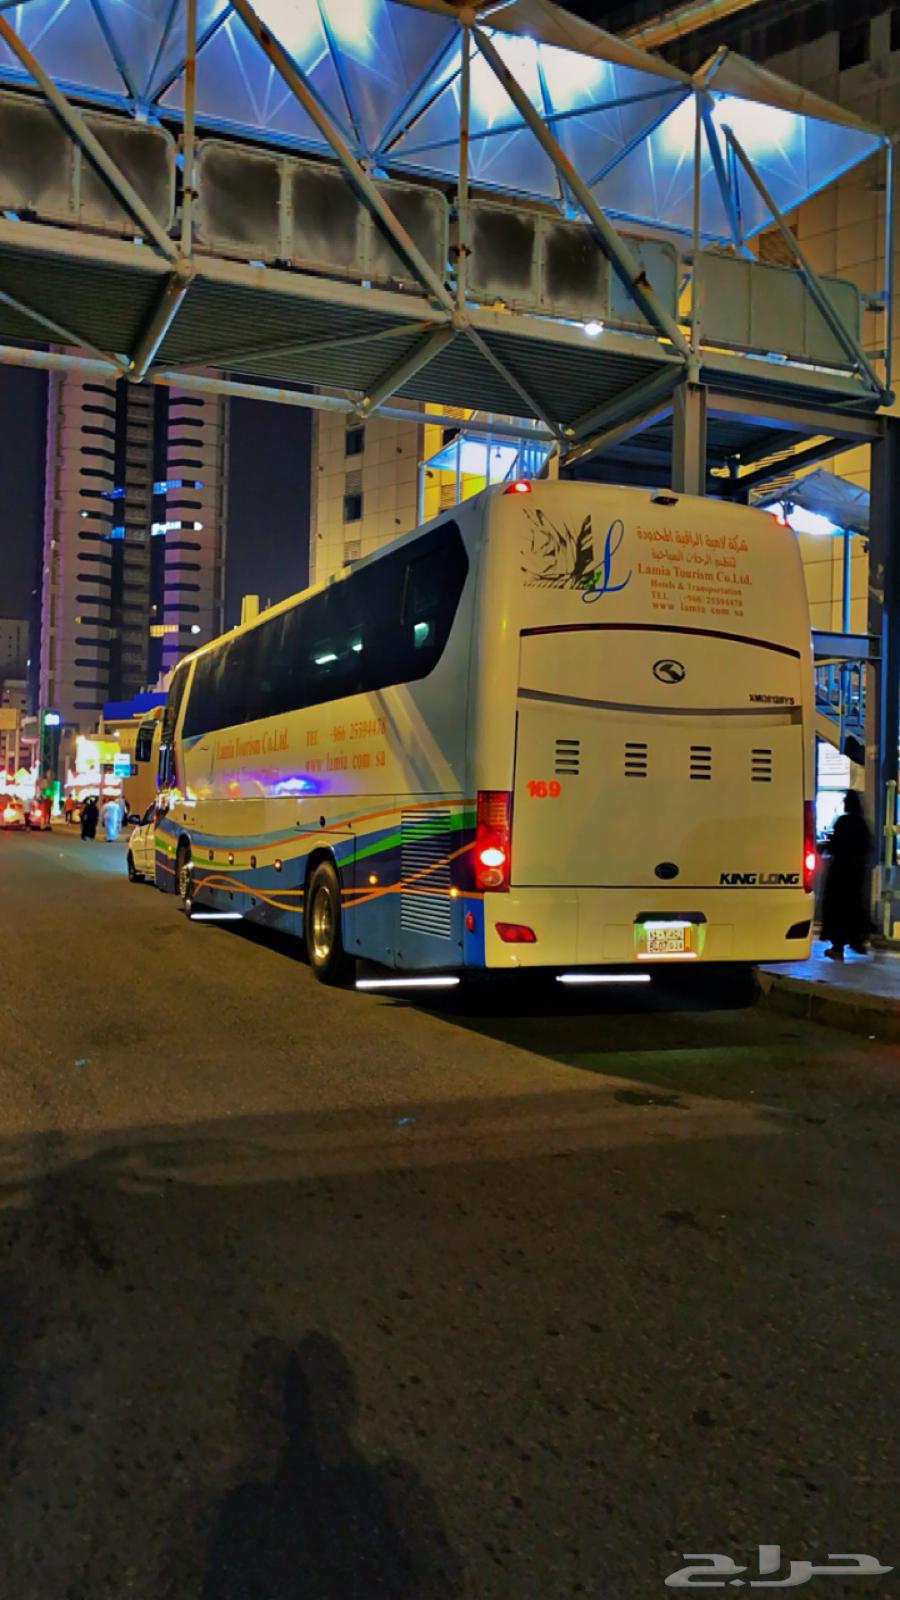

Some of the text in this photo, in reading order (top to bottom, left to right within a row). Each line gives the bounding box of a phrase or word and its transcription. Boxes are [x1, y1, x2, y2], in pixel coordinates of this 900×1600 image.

[638, 563, 671, 576] Lamia
[674, 566, 714, 581] Tourism
[650, 579, 742, 596] Hotels & Transportation
[526, 779, 561, 799] 169
[720, 873, 800, 885] KING LONG
